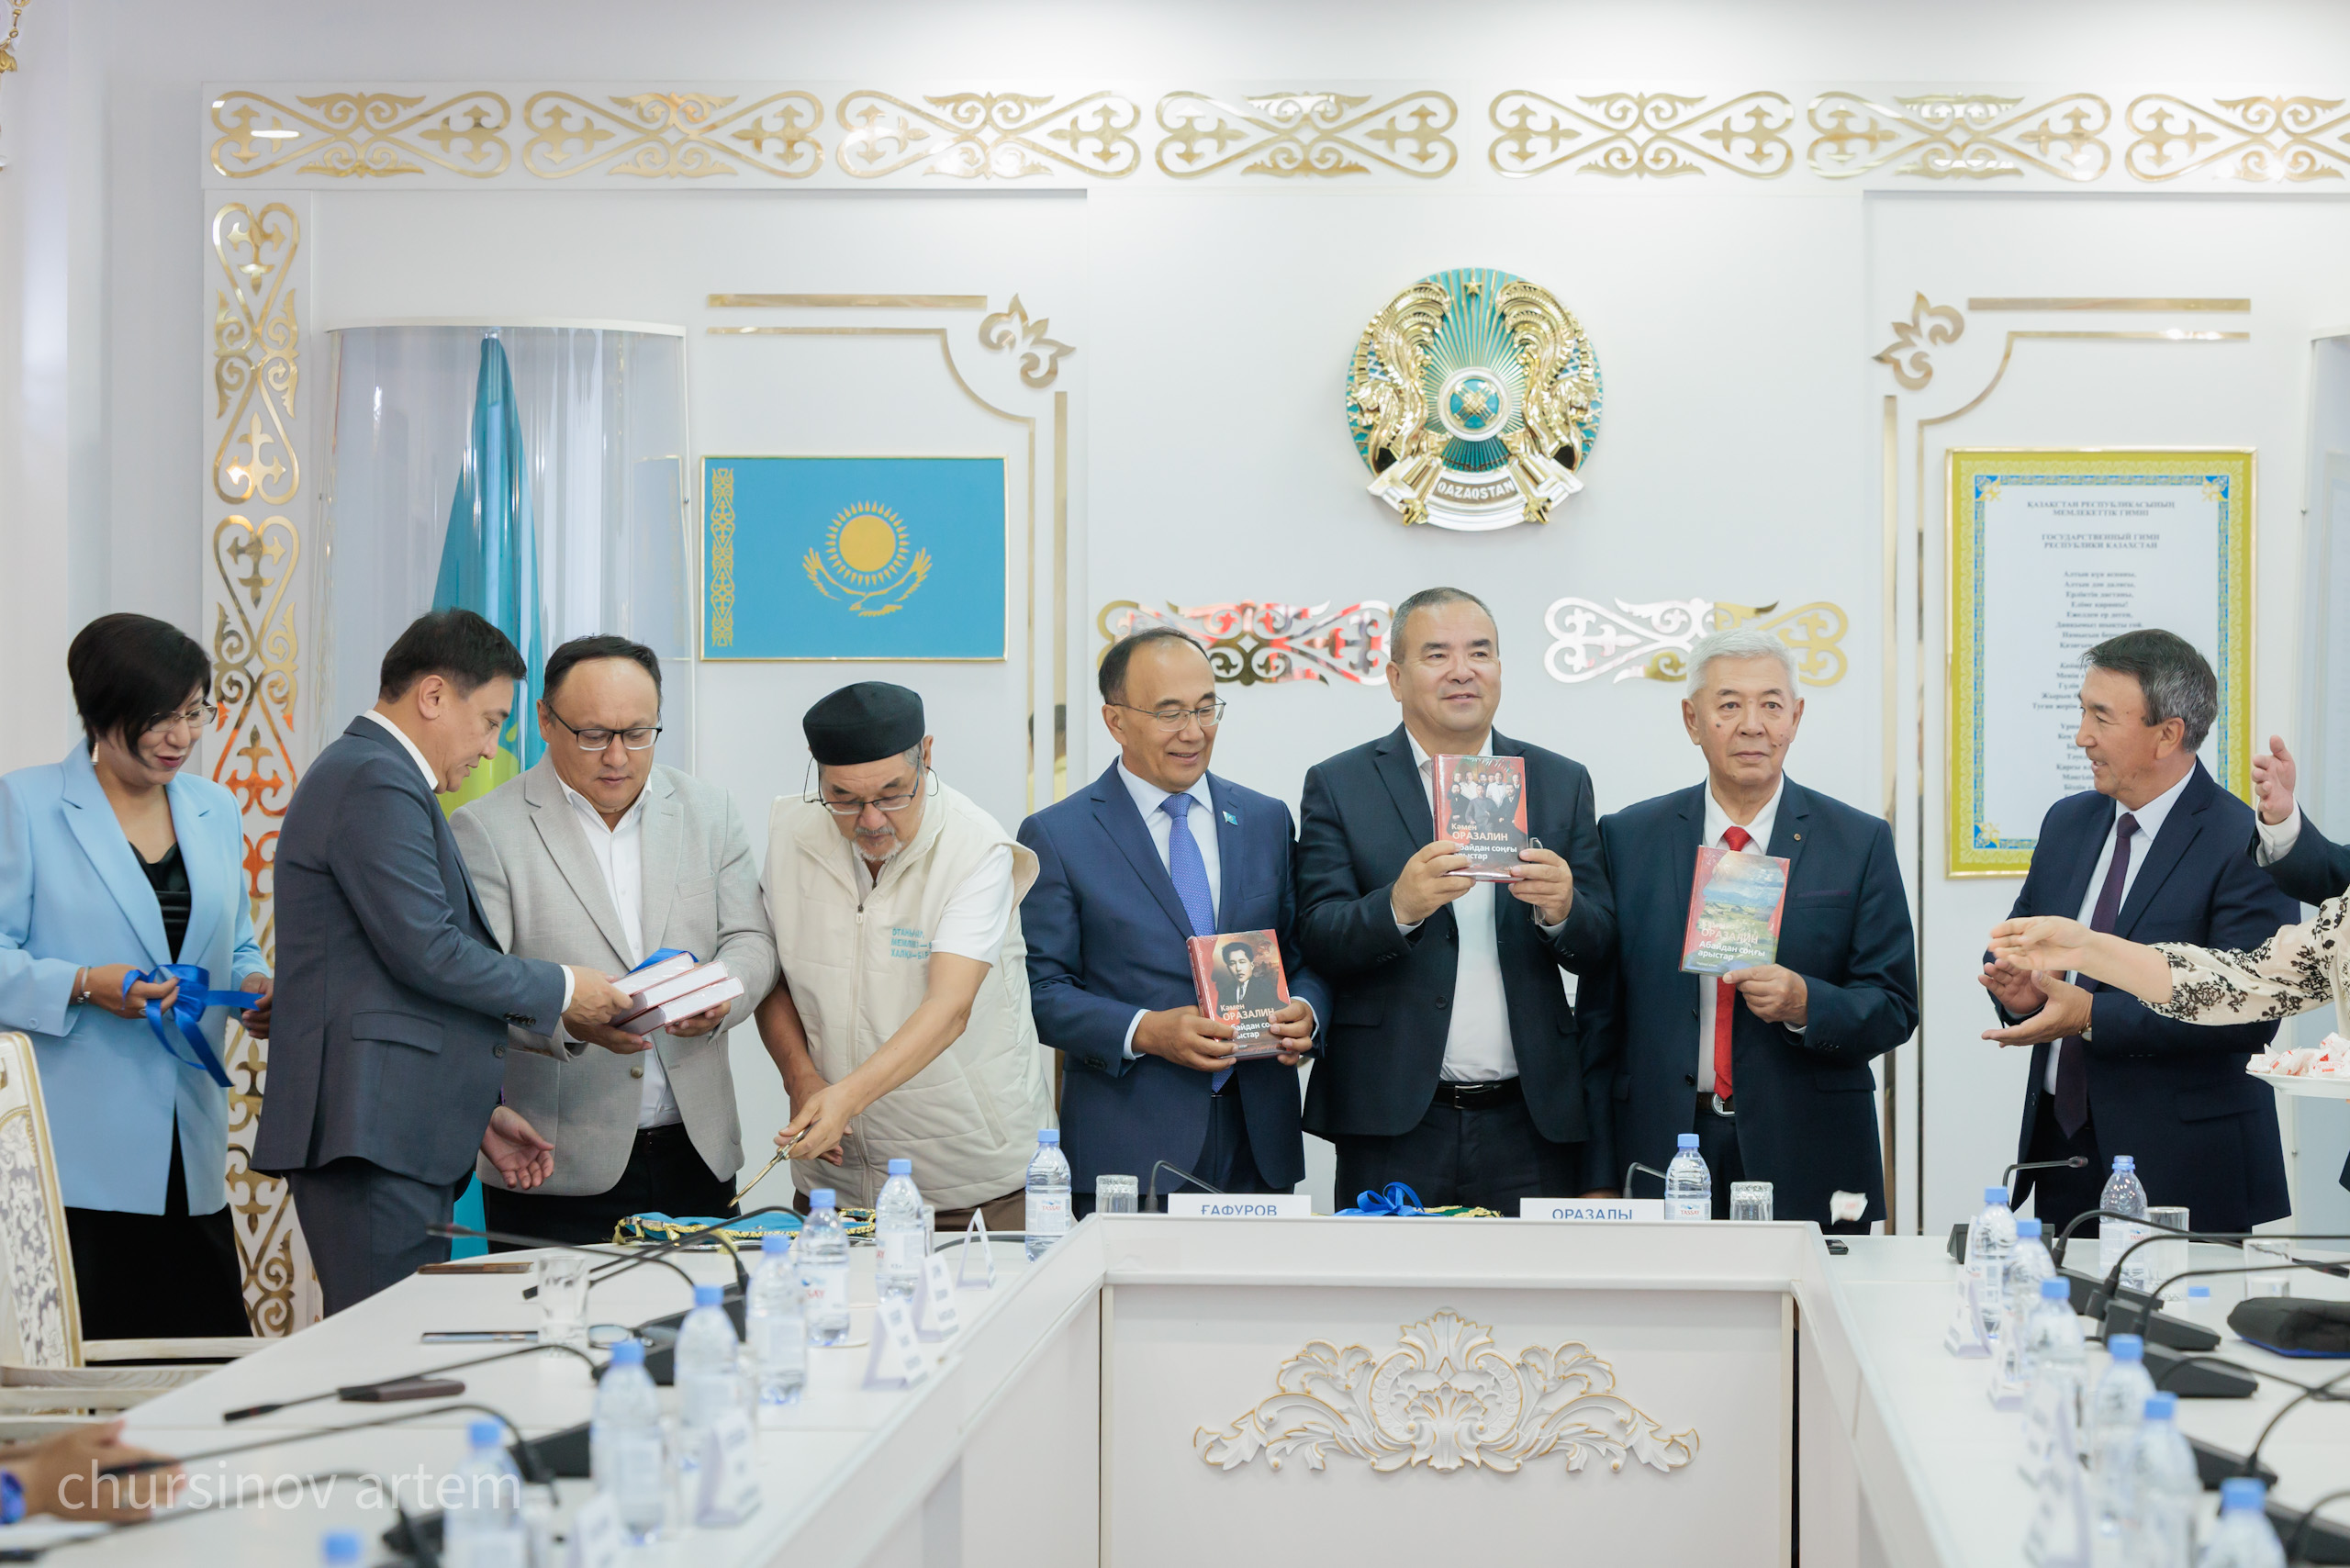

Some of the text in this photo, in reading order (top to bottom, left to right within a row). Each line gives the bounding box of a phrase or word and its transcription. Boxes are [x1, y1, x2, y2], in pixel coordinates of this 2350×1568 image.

[1437, 480, 1516, 499] QAZAQSTAN
[1451, 823, 1477, 831] Кәмен
[1452, 831, 1508, 841] ОРАЗАЛИН
[1460, 843, 1490, 852] байдан
[1701, 927, 1759, 945] ОРАЗАЛИН
[1698, 940, 1765, 957] Абайдан соңғы
[1697, 950, 1734, 961] арыстар
[1220, 1003, 1245, 1012] Кәмен
[1223, 1007, 1275, 1021] ОРАЗАЛИН
[1231, 1022, 1260, 1031] байдан
[1201, 1204, 1277, 1215] ҒАФУРОВ
